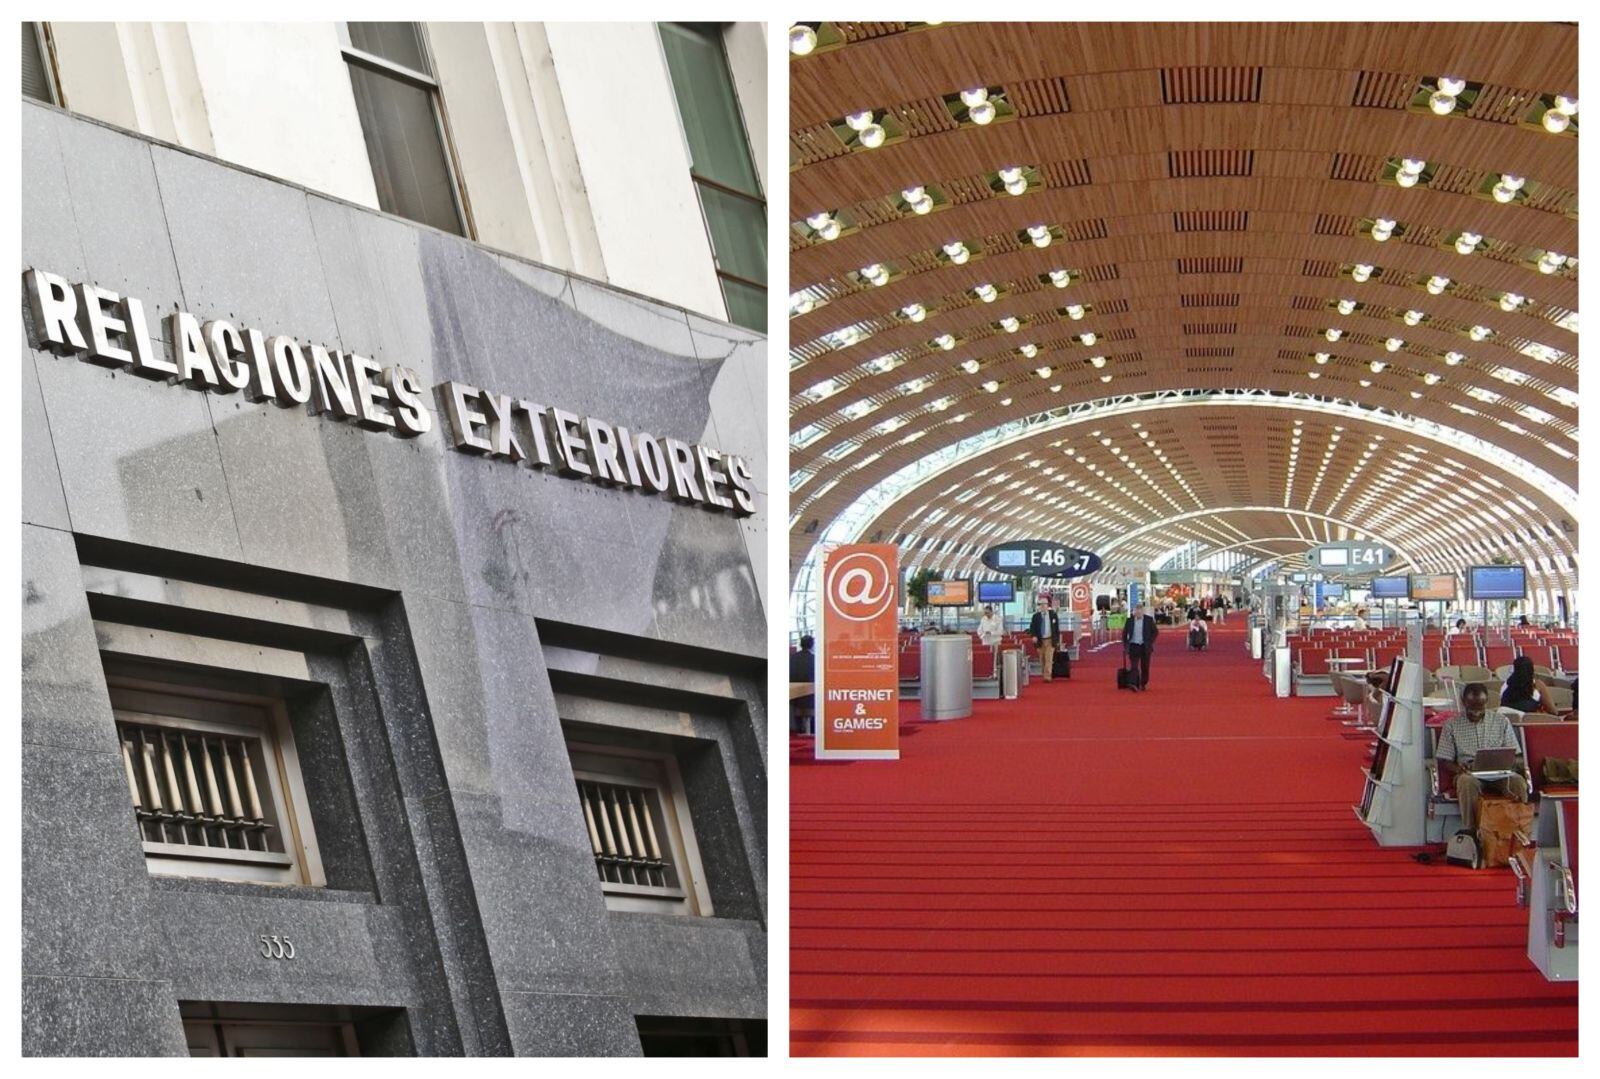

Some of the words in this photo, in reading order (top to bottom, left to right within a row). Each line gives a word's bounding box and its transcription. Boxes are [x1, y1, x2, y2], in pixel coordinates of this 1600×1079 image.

[25, 268, 433, 437] RELACIONES
[438, 381, 756, 517] EXTERIORES
[1030, 549, 1066, 567] E46
[1352, 548, 1384, 565] E41
[828, 689, 894, 701] INTERNET
[855, 702, 866, 715] &
[260, 934, 295, 959] 535
